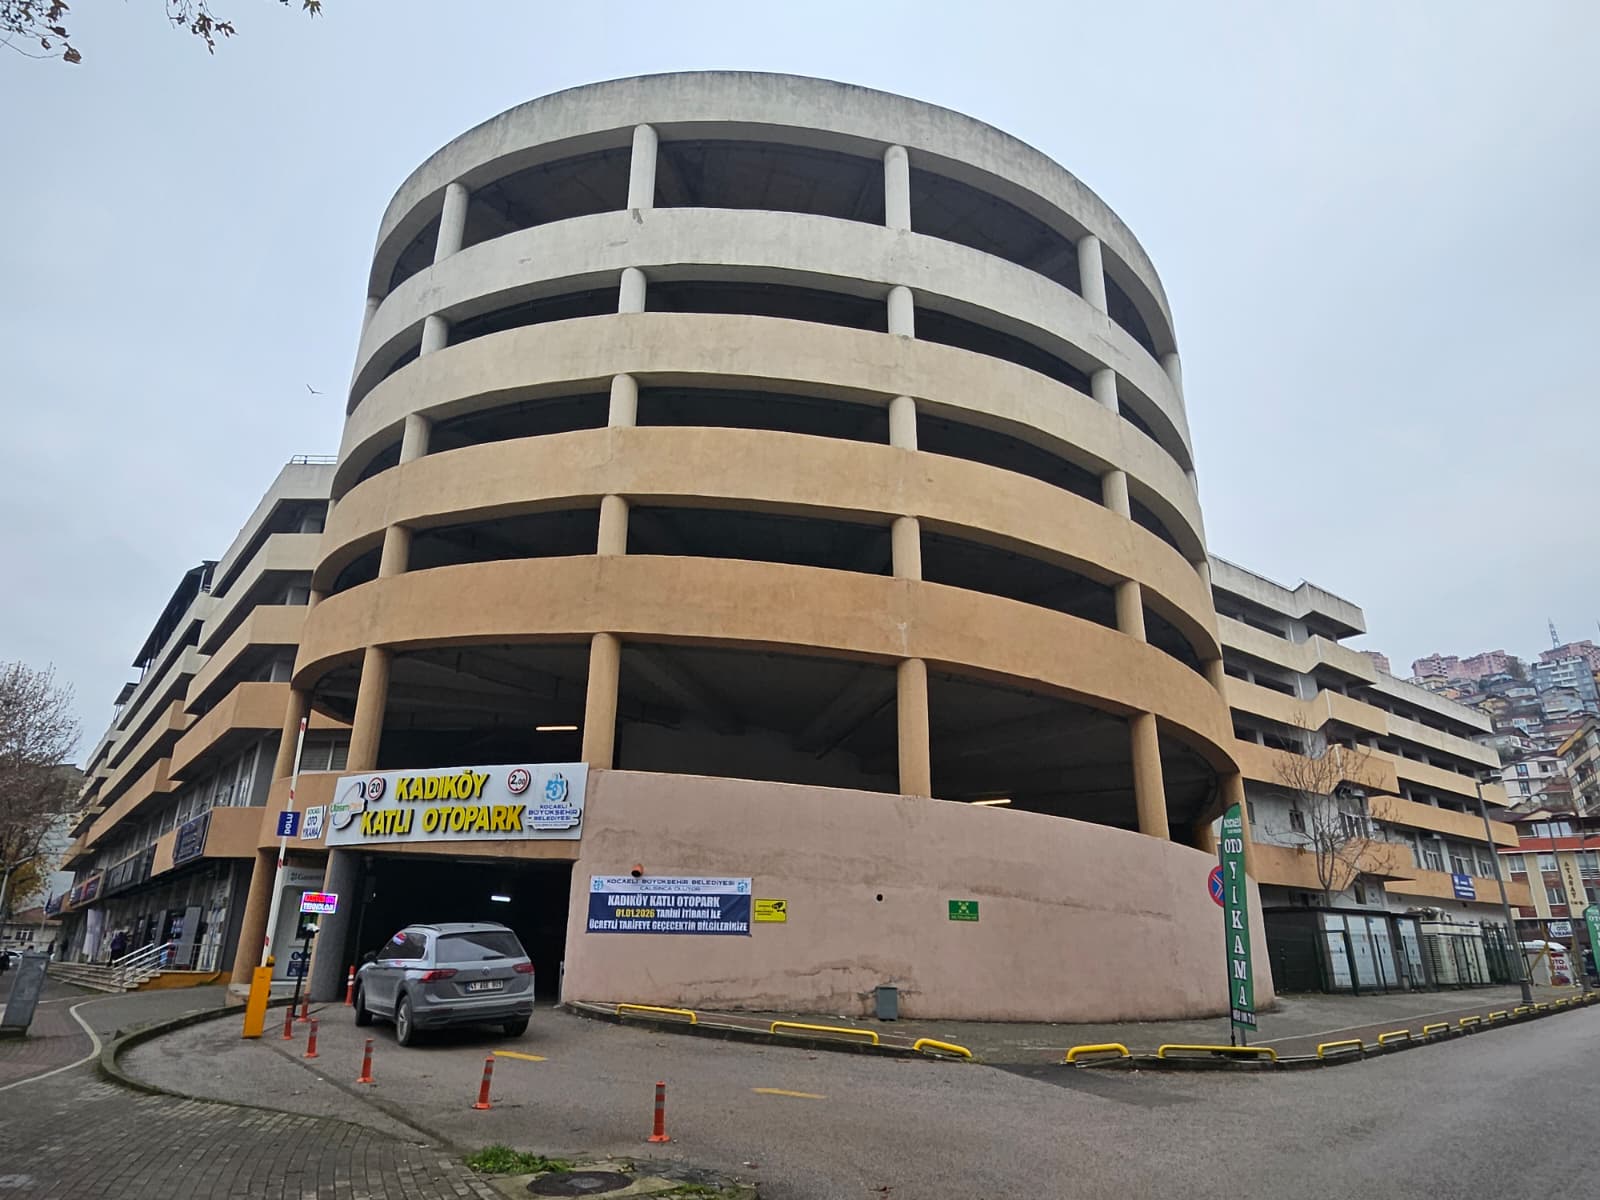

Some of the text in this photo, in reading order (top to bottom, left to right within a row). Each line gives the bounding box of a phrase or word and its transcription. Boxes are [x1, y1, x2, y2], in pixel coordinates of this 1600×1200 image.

[370, 782, 380, 793] 20
[395, 770, 488, 800] KADIKÖY
[284, 813, 294, 834] DOLU
[307, 816, 317, 826] OTO
[361, 805, 524, 835] KATLI OTOPARK
[1224, 838, 1242, 854] OTO
[608, 894, 720, 908] KADIKÖY KATLI OTOPARK
[615, 908, 655, 918] 01.01.2026
[656, 908, 680, 918] TARİHİ
[710, 909, 721, 919] İLE
[589, 919, 618, 929] ÜCRETLİ
[619, 919, 651, 930] TARİFEYE
[652, 920, 696, 931] GEÇECEKTİR
[1228, 861, 1248, 1006] YIKAMA
